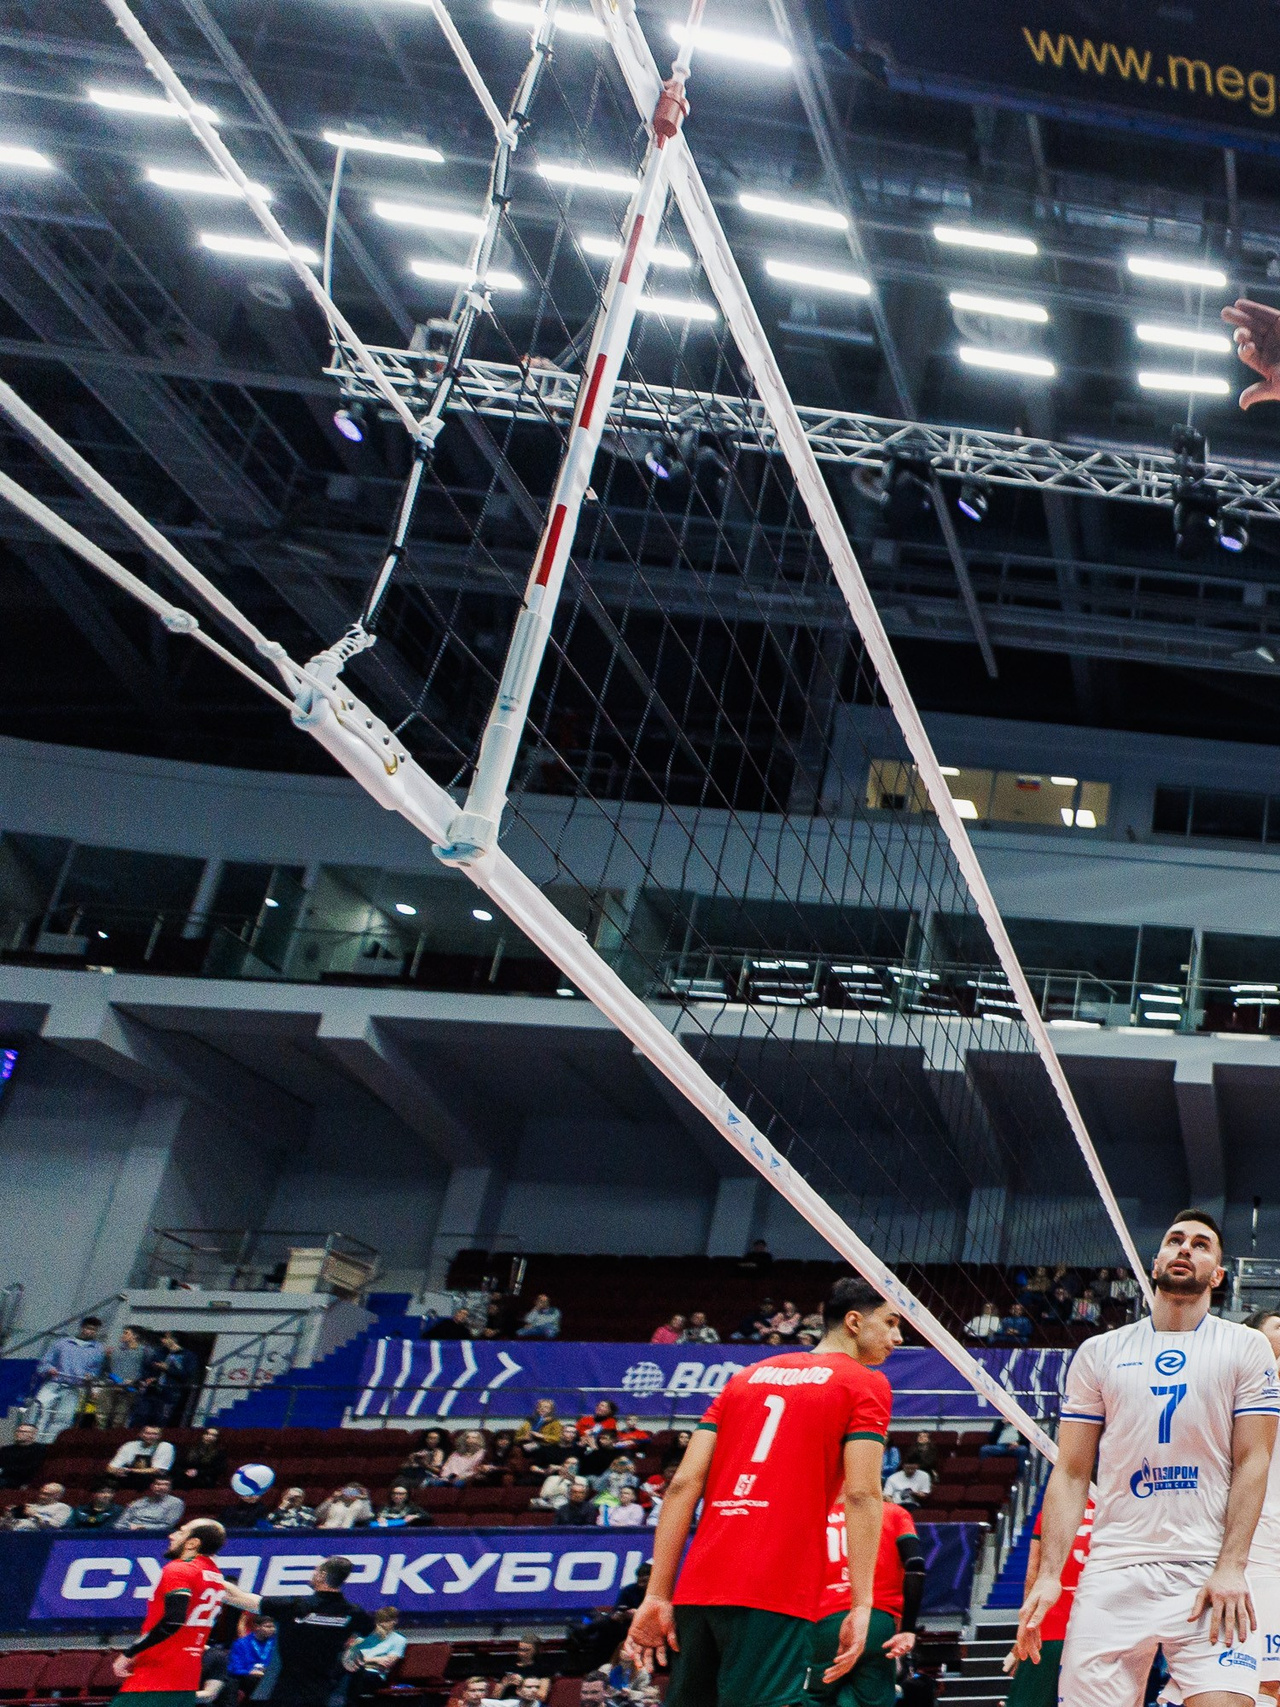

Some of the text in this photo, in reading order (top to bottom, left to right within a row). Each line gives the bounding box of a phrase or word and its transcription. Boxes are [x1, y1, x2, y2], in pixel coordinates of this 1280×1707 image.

[747, 1366, 834, 1386] НИКОЛОВ
[751, 1394, 786, 1463] 1
[1149, 1383, 1187, 1444] 7
[1152, 1465, 1199, 1481] ГАЗПРОМ
